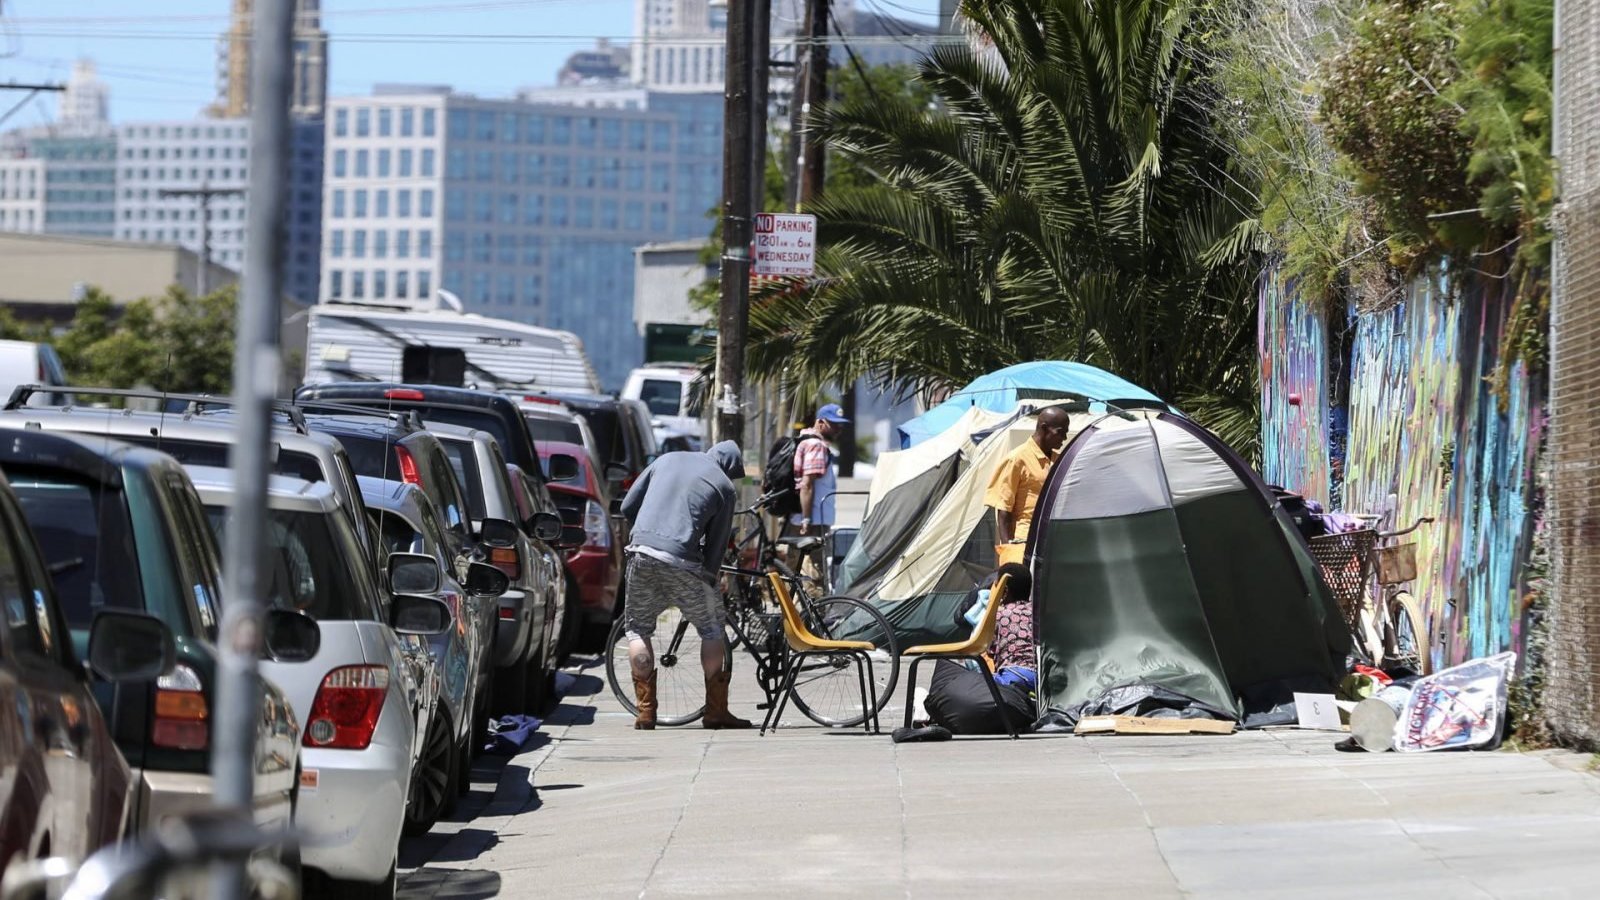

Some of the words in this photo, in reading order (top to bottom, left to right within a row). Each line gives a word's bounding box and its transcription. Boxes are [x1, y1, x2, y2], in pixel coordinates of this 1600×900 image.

[757, 215, 773, 231] NO
[776, 220, 812, 232] PARKING
[758, 251, 811, 262] WEDNESDAY
